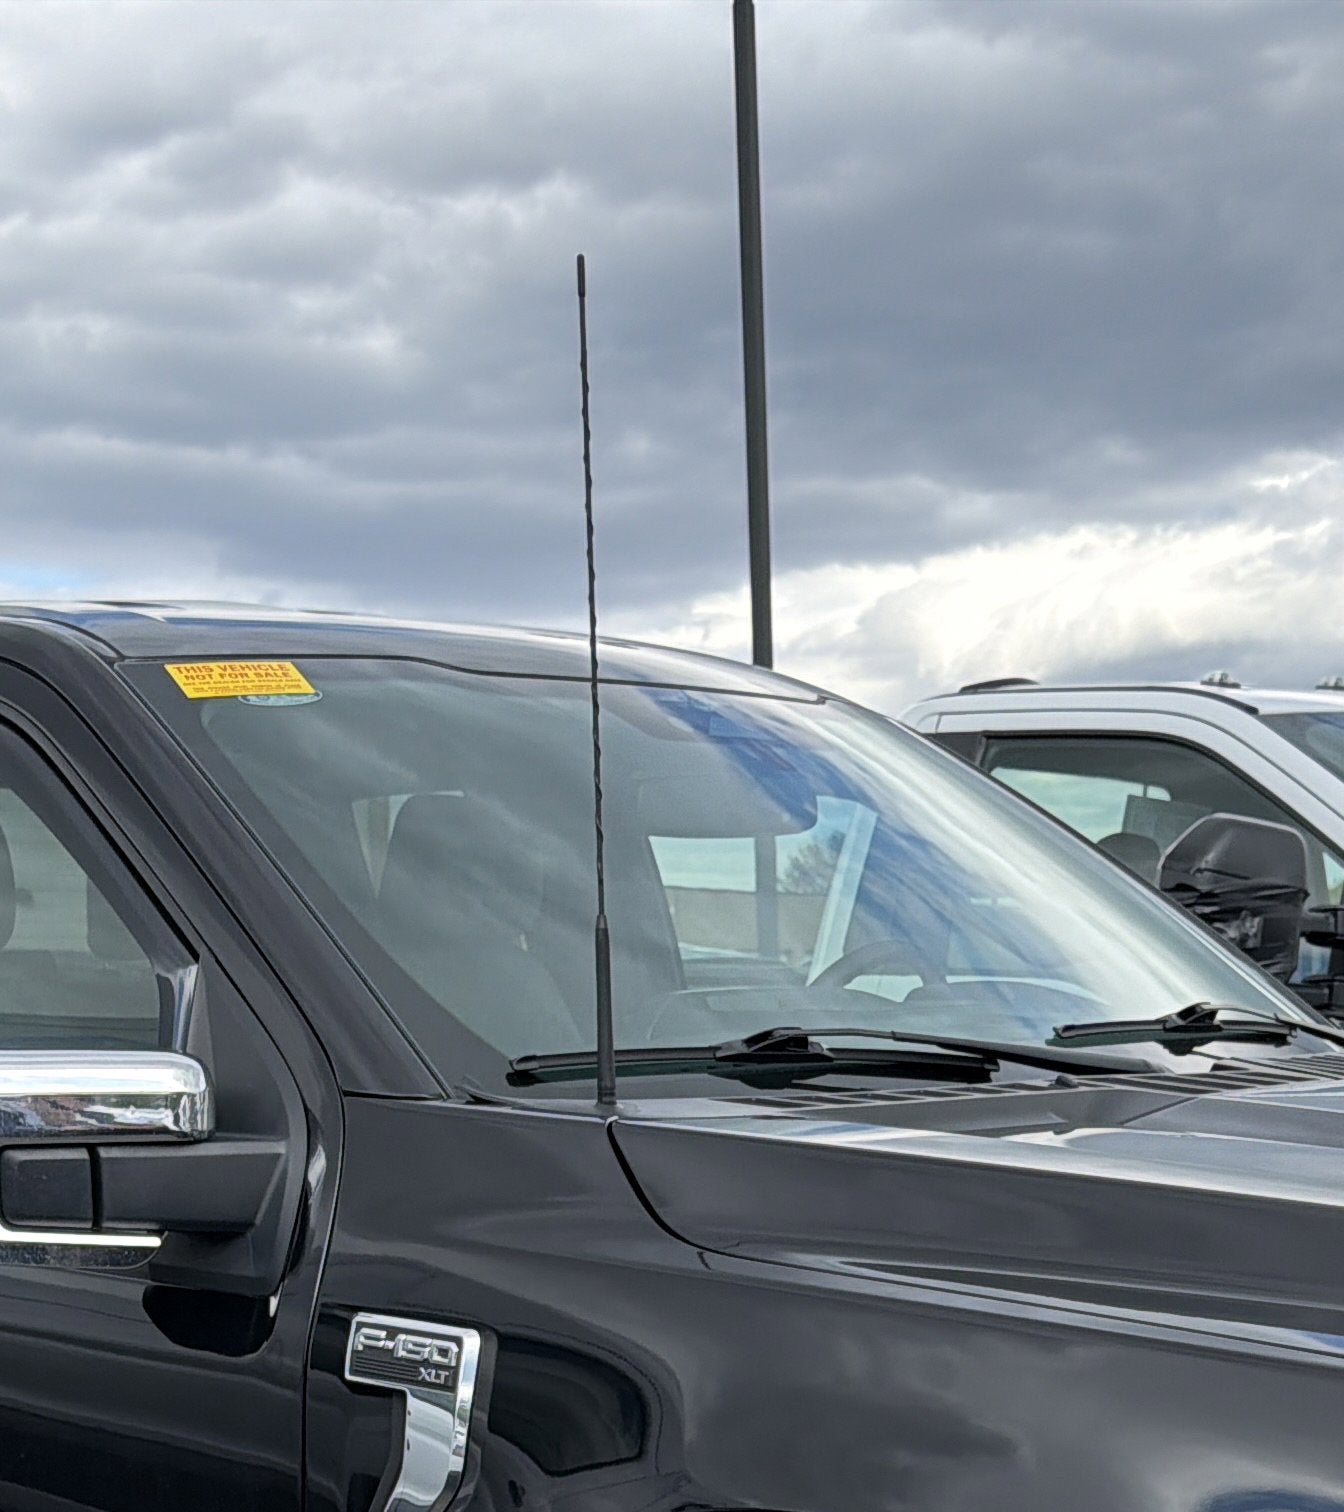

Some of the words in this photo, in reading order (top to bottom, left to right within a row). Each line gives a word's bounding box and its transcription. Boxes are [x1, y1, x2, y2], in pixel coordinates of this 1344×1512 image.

[173, 666, 214, 674] THIS
[217, 664, 290, 673] VEHICLE
[183, 673, 214, 681] NOT
[353, 1327, 459, 1366] F-150
[418, 1367, 450, 1385] XLT
